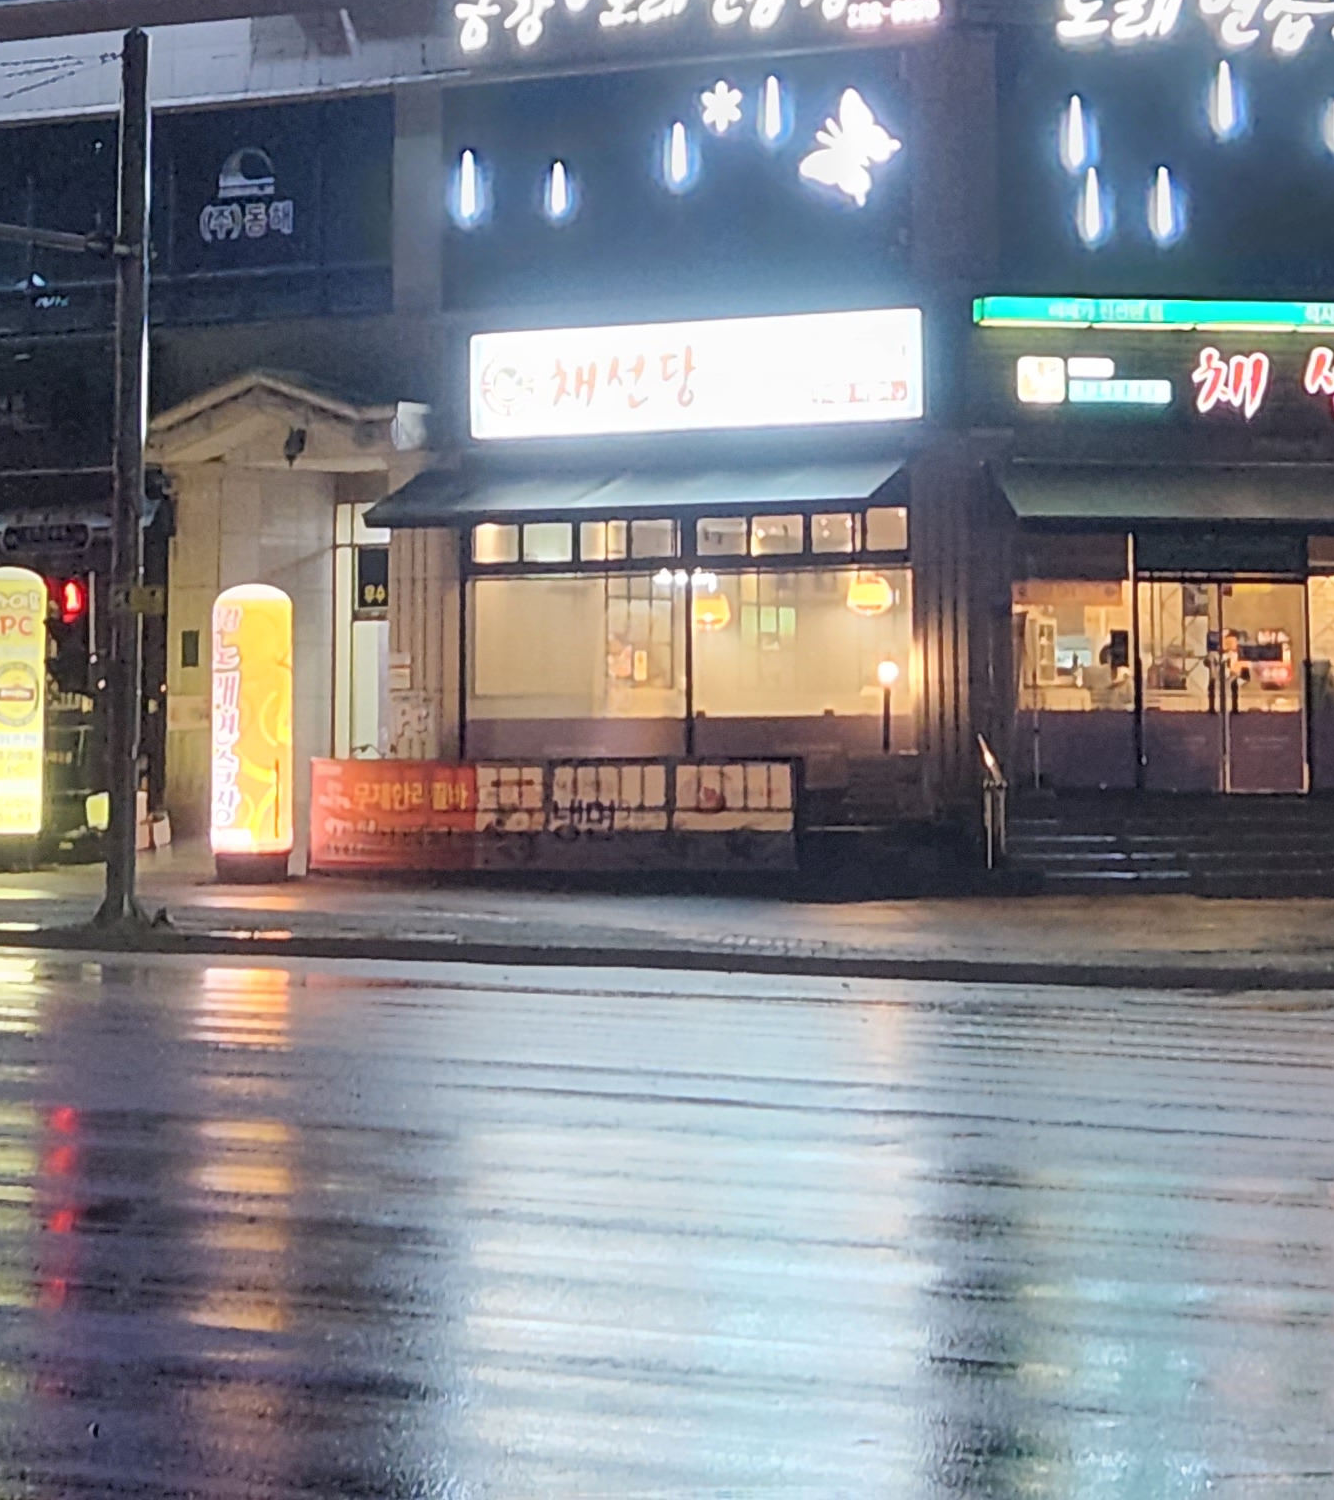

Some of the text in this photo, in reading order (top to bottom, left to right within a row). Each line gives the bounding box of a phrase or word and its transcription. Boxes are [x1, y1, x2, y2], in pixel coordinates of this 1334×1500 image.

[199, 200, 295, 242] (주)동해
[551, 345, 696, 408] 채선당
[0, 615, 34, 637] PC
